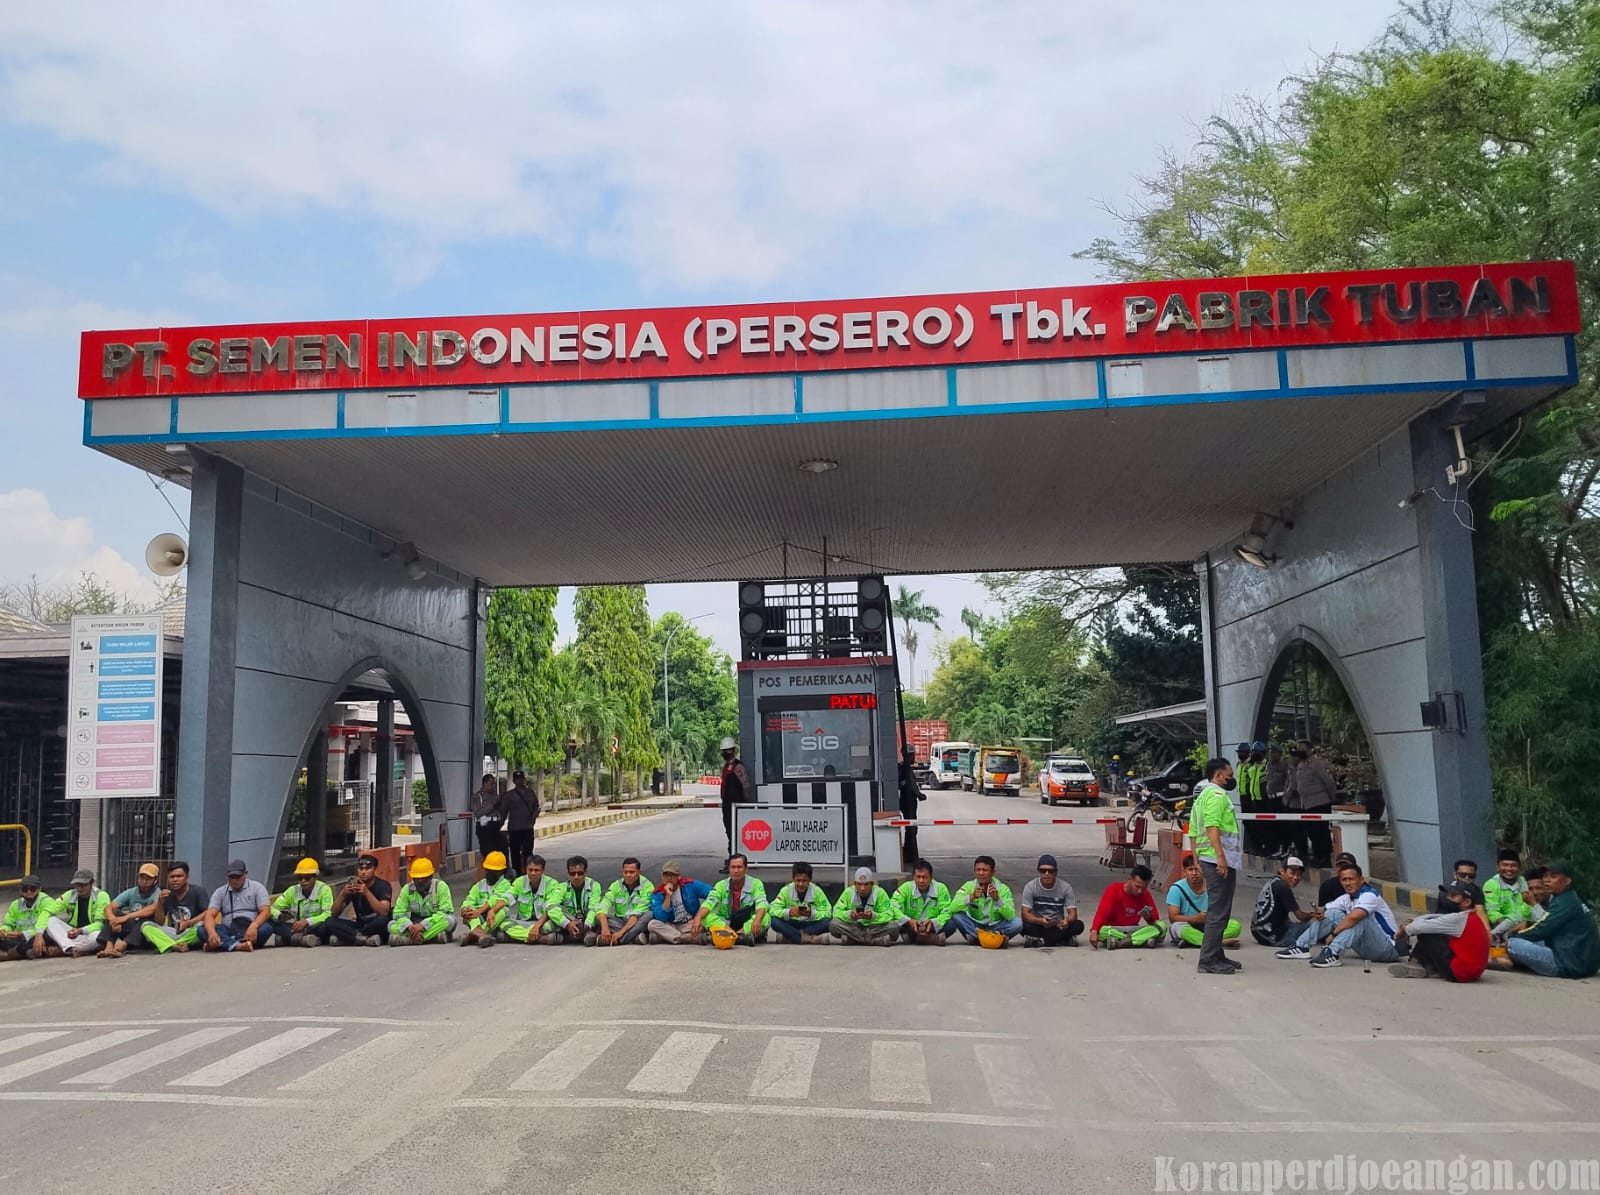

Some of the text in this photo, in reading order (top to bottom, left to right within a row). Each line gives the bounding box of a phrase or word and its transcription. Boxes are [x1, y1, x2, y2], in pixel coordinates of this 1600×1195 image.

[103, 276, 1551, 378] PT. SEMEN INDONESIA (PERSERO) Tbk. PABRIK TUBAN
[758, 674, 873, 688] POS PEMERIKSAAN
[800, 735, 840, 751] SIG
[781, 820, 829, 833] TAMU HARAP
[744, 830, 770, 841] STOP
[775, 839, 839, 852] LAPOR SECURITY
